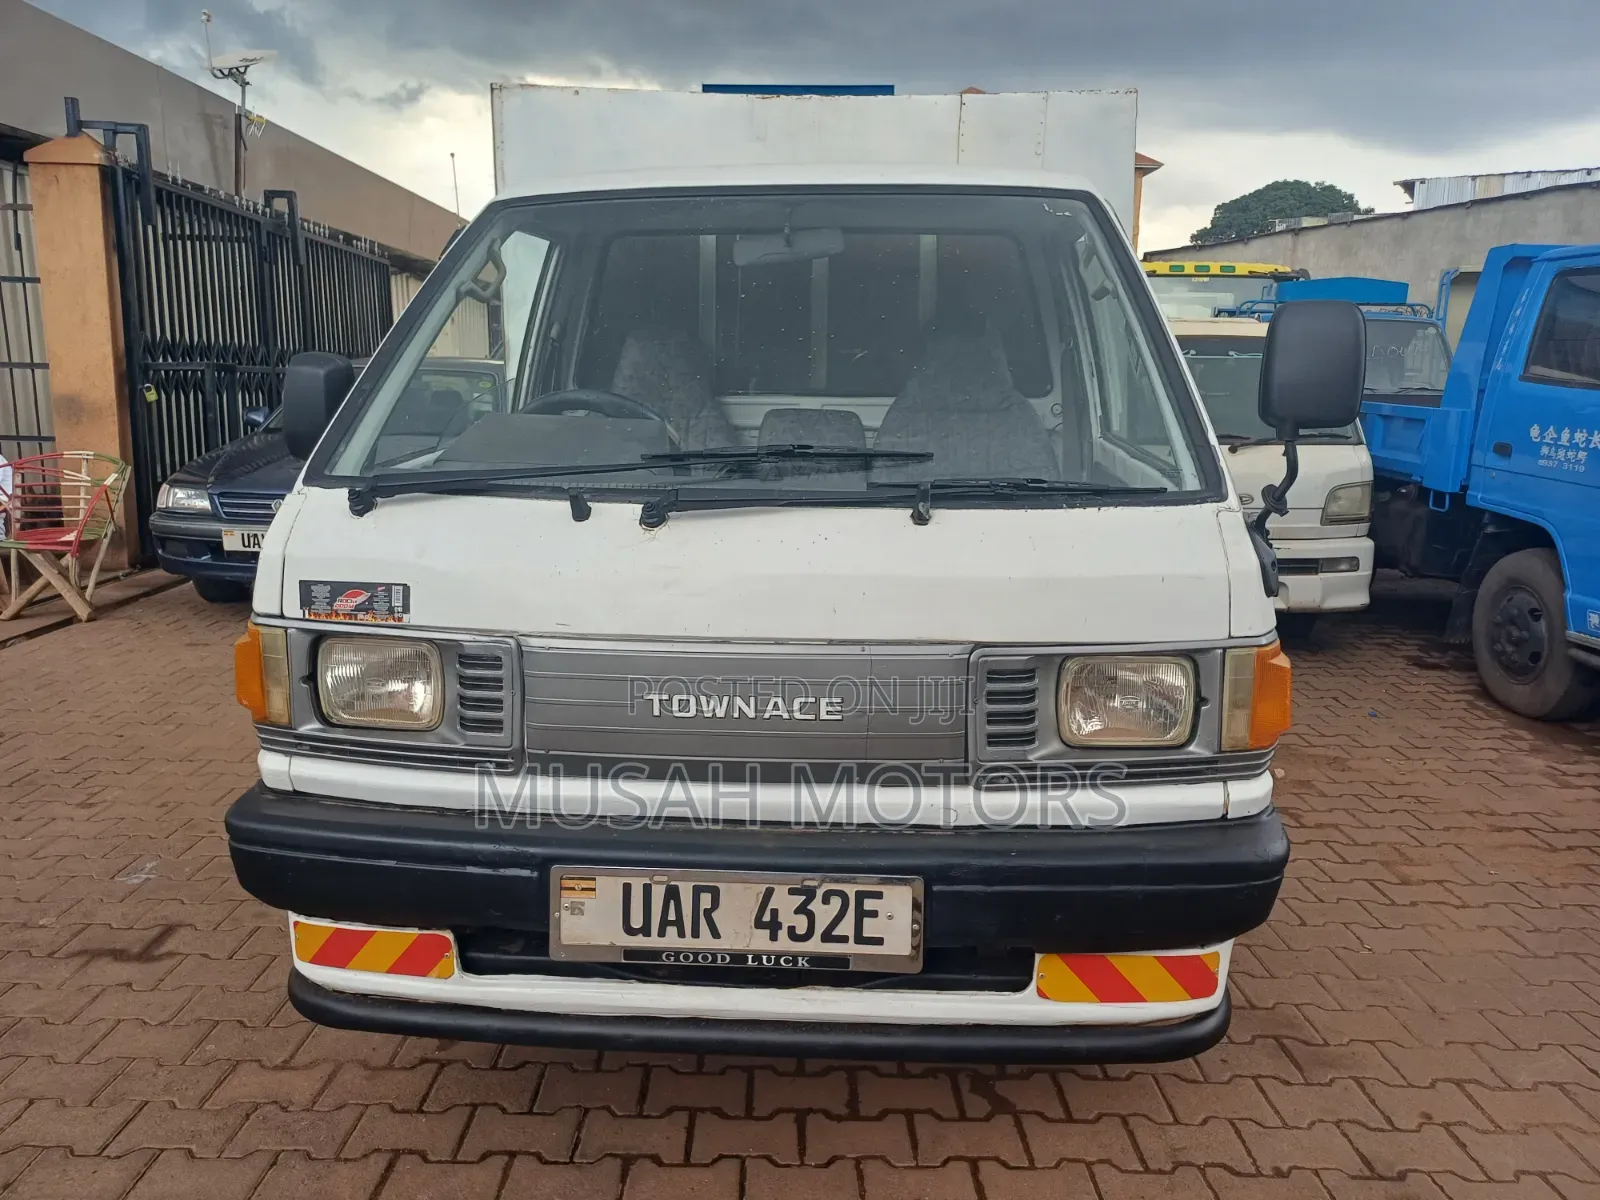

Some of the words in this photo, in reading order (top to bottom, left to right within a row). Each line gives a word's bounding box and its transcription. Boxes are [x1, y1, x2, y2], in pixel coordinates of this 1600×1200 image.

[241, 533, 265, 549] UA
[622, 881, 721, 940] UAR
[753, 886, 885, 946] 432E
[661, 951, 731, 965] GOOD
[746, 954, 811, 968] LUCK
